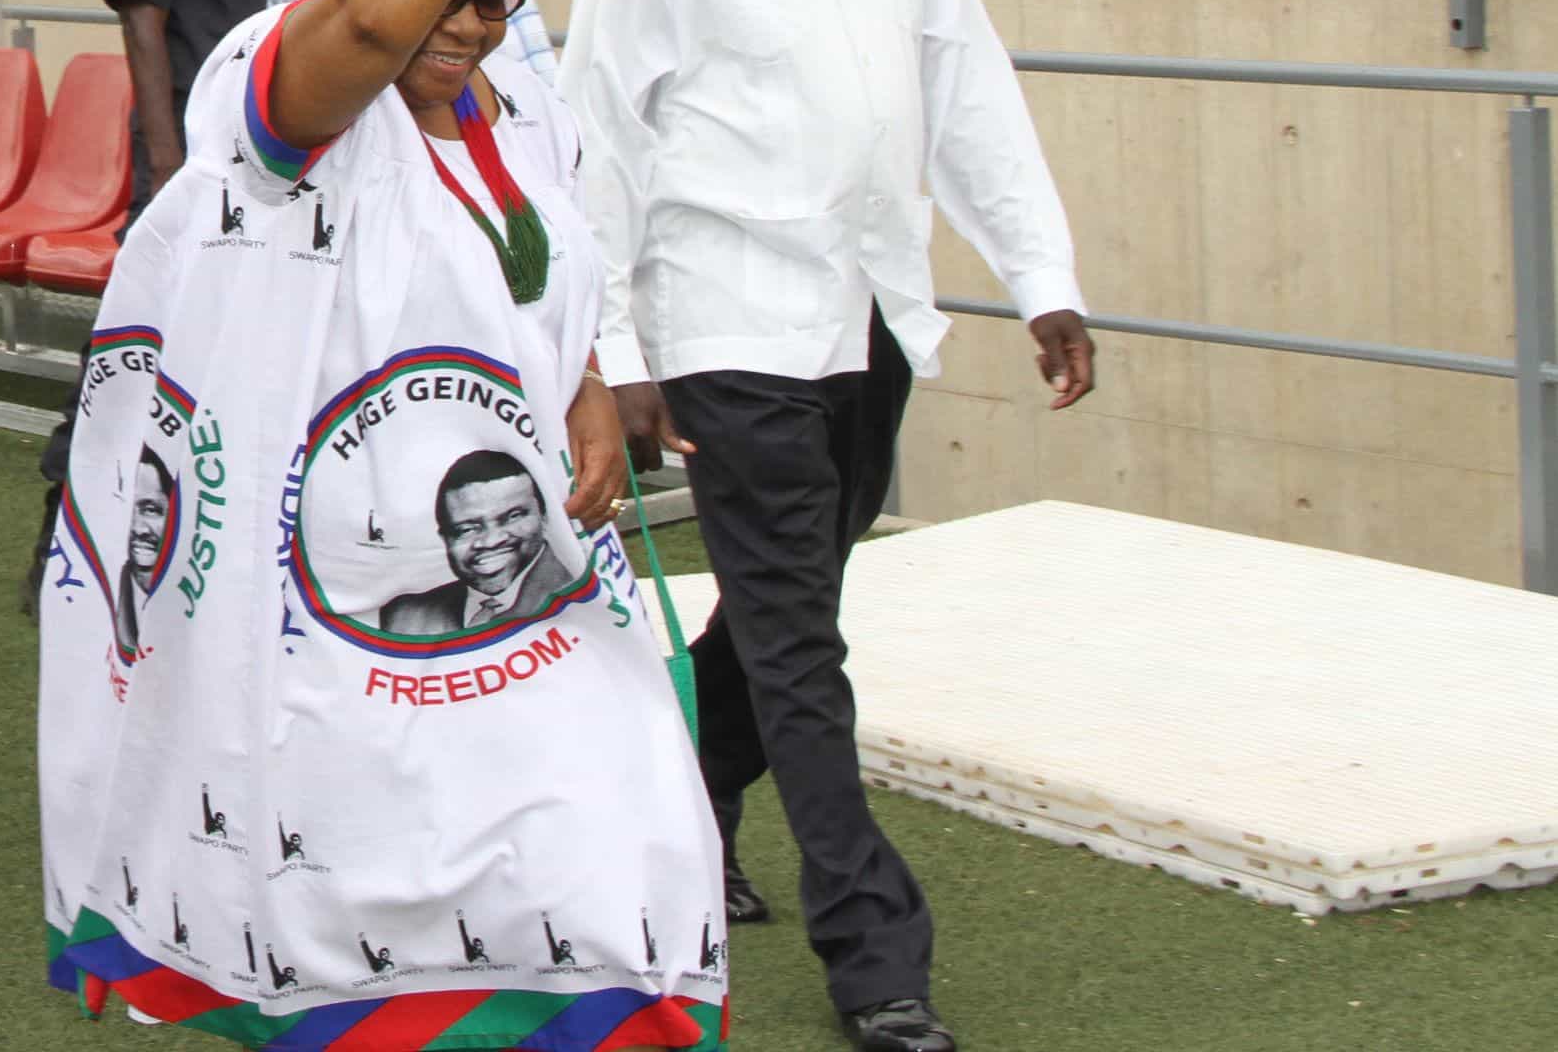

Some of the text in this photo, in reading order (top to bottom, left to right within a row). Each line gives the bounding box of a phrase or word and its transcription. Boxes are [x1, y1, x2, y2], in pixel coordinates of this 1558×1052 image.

[331, 390, 397, 460] HAGE
[178, 408, 227, 619] JUSTICE.
[364, 627, 581, 707] FREEDOM.
